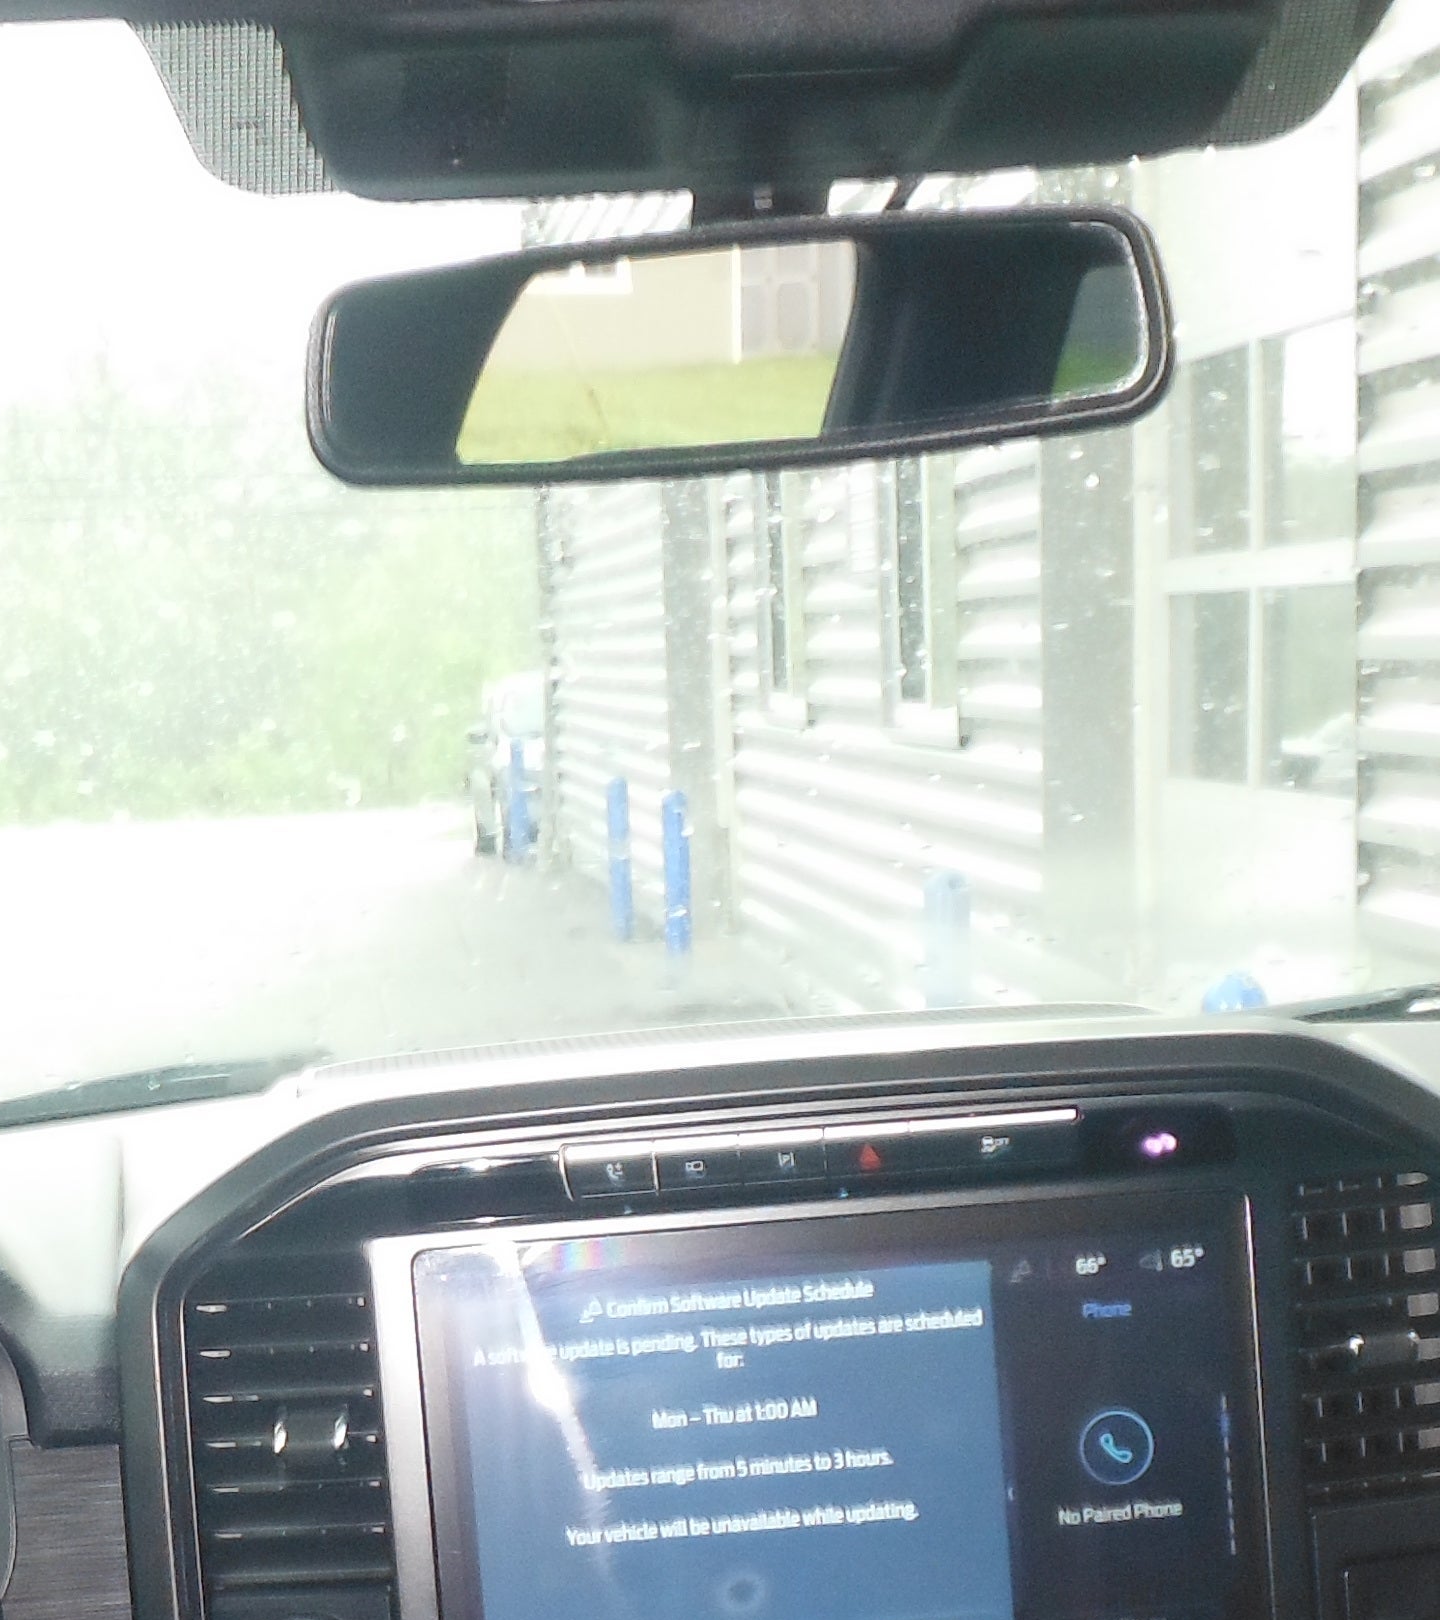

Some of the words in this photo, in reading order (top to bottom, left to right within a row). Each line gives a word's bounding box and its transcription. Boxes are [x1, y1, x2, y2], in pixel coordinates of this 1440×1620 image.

[606, 1298, 669, 1319] Confirm
[670, 1292, 741, 1313] Software
[743, 1287, 802, 1308] Update
[803, 1280, 875, 1302] Schedule
[473, 1350, 486, 1366] A
[560, 1340, 615, 1362] update
[616, 1338, 630, 1355] is
[701, 1329, 747, 1348] These
[748, 1324, 793, 1346] types
[794, 1321, 812, 1340] of
[813, 1316, 876, 1341] updates
[877, 1316, 904, 1334] are
[905, 1308, 984, 1331] scheduled
[652, 1410, 689, 1429] Mon
[702, 1405, 734, 1425] Thu
[735, 1404, 753, 1422] at
[755, 1401, 788, 1421] 1:00
[790, 1398, 818, 1418] AM
[583, 1469, 650, 1492] Updates
[651, 1467, 696, 1486] range
[697, 1462, 735, 1481] from
[736, 1460, 747, 1479] 5
[749, 1455, 811, 1476] minutes
[814, 1454, 831, 1471] to
[833, 1450, 843, 1469] 3
[566, 1528, 605, 1547] Your
[605, 1521, 658, 1543] vehicle
[660, 1517, 688, 1538] will
[690, 1516, 710, 1536] be
[711, 1509, 800, 1534] unavailable
[802, 1505, 844, 1526] while
[1058, 1505, 1081, 1526] No
[1082, 1502, 1132, 1524] Paired
[1133, 1498, 1183, 1520] Phone
